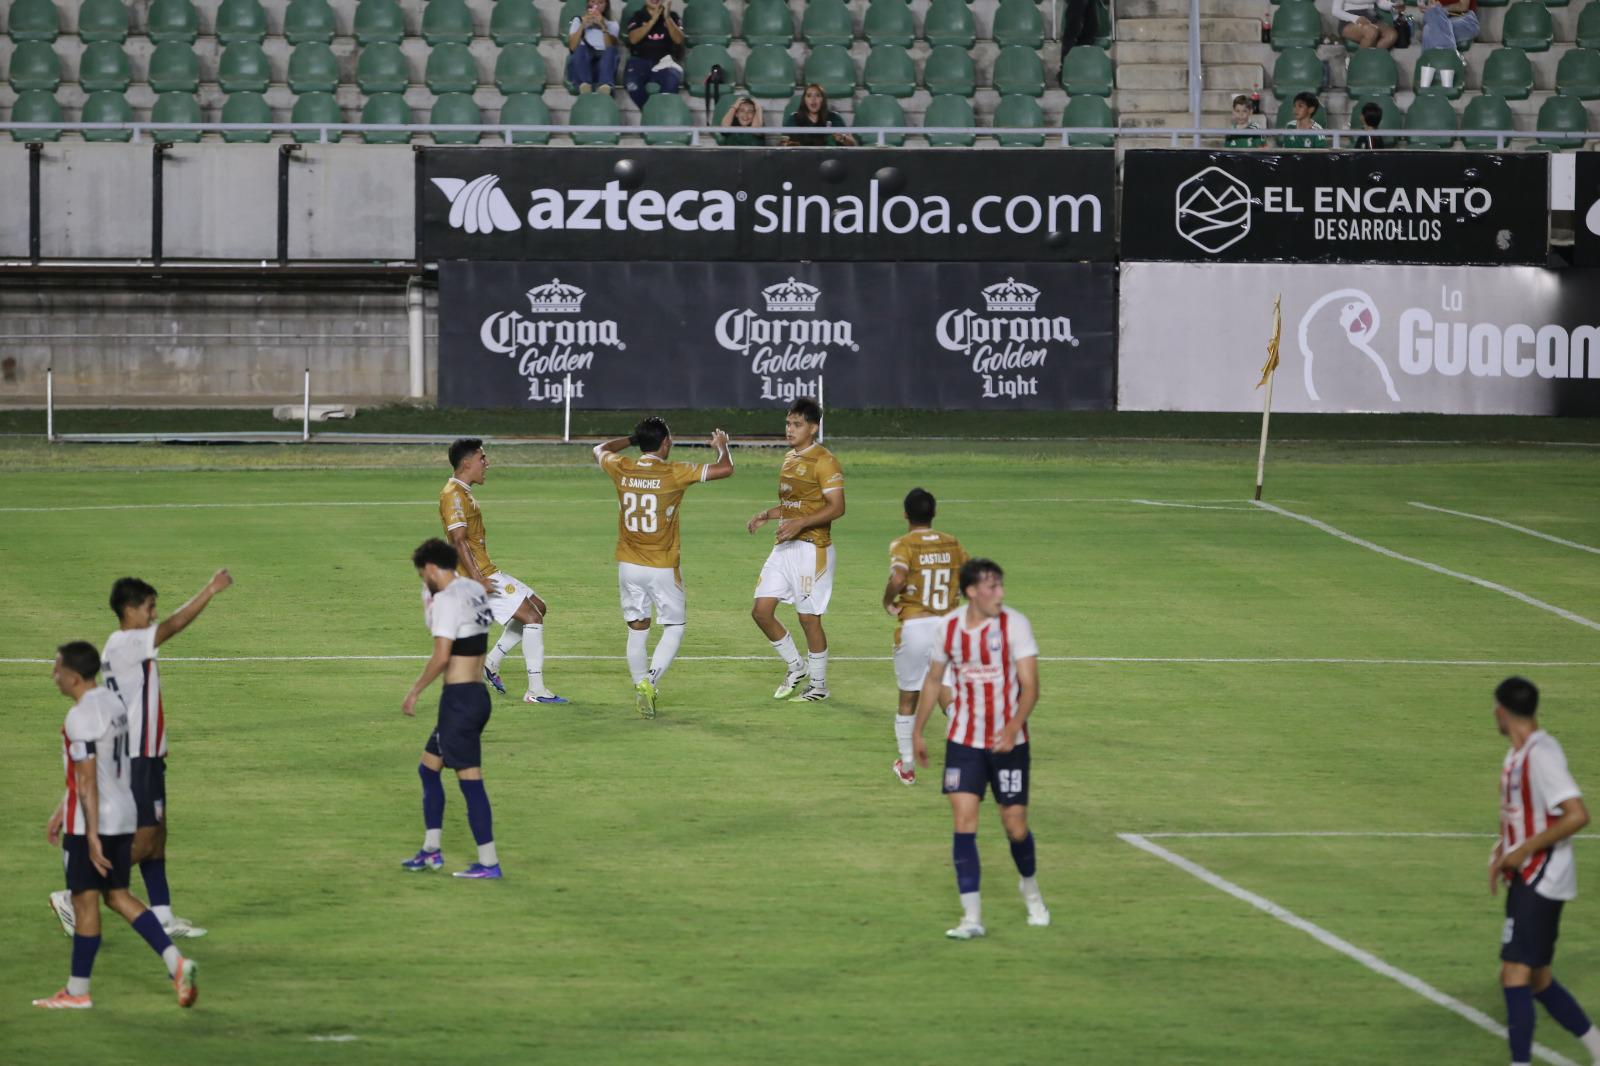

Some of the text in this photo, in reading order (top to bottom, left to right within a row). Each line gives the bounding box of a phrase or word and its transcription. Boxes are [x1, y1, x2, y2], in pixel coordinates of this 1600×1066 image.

[527, 179, 1102, 234] azteca sinaloa.com
[1264, 187, 1492, 214] EL ENCANTO
[1314, 218, 1442, 241] DESARROLLOS
[480, 310, 621, 358] Corona
[715, 308, 855, 356] Corona
[936, 308, 1075, 355] Corona
[518, 345, 594, 376] Golden
[752, 344, 827, 375] Golden
[972, 342, 1048, 373] Golden
[760, 375, 818, 402] Light
[982, 374, 1039, 399] Light
[628, 477, 661, 489] SANCHEZ
[623, 492, 658, 533] 23
[919, 552, 951, 565] CASTILLO
[800, 575, 813, 594] 18
[921, 568, 951, 610] 15
